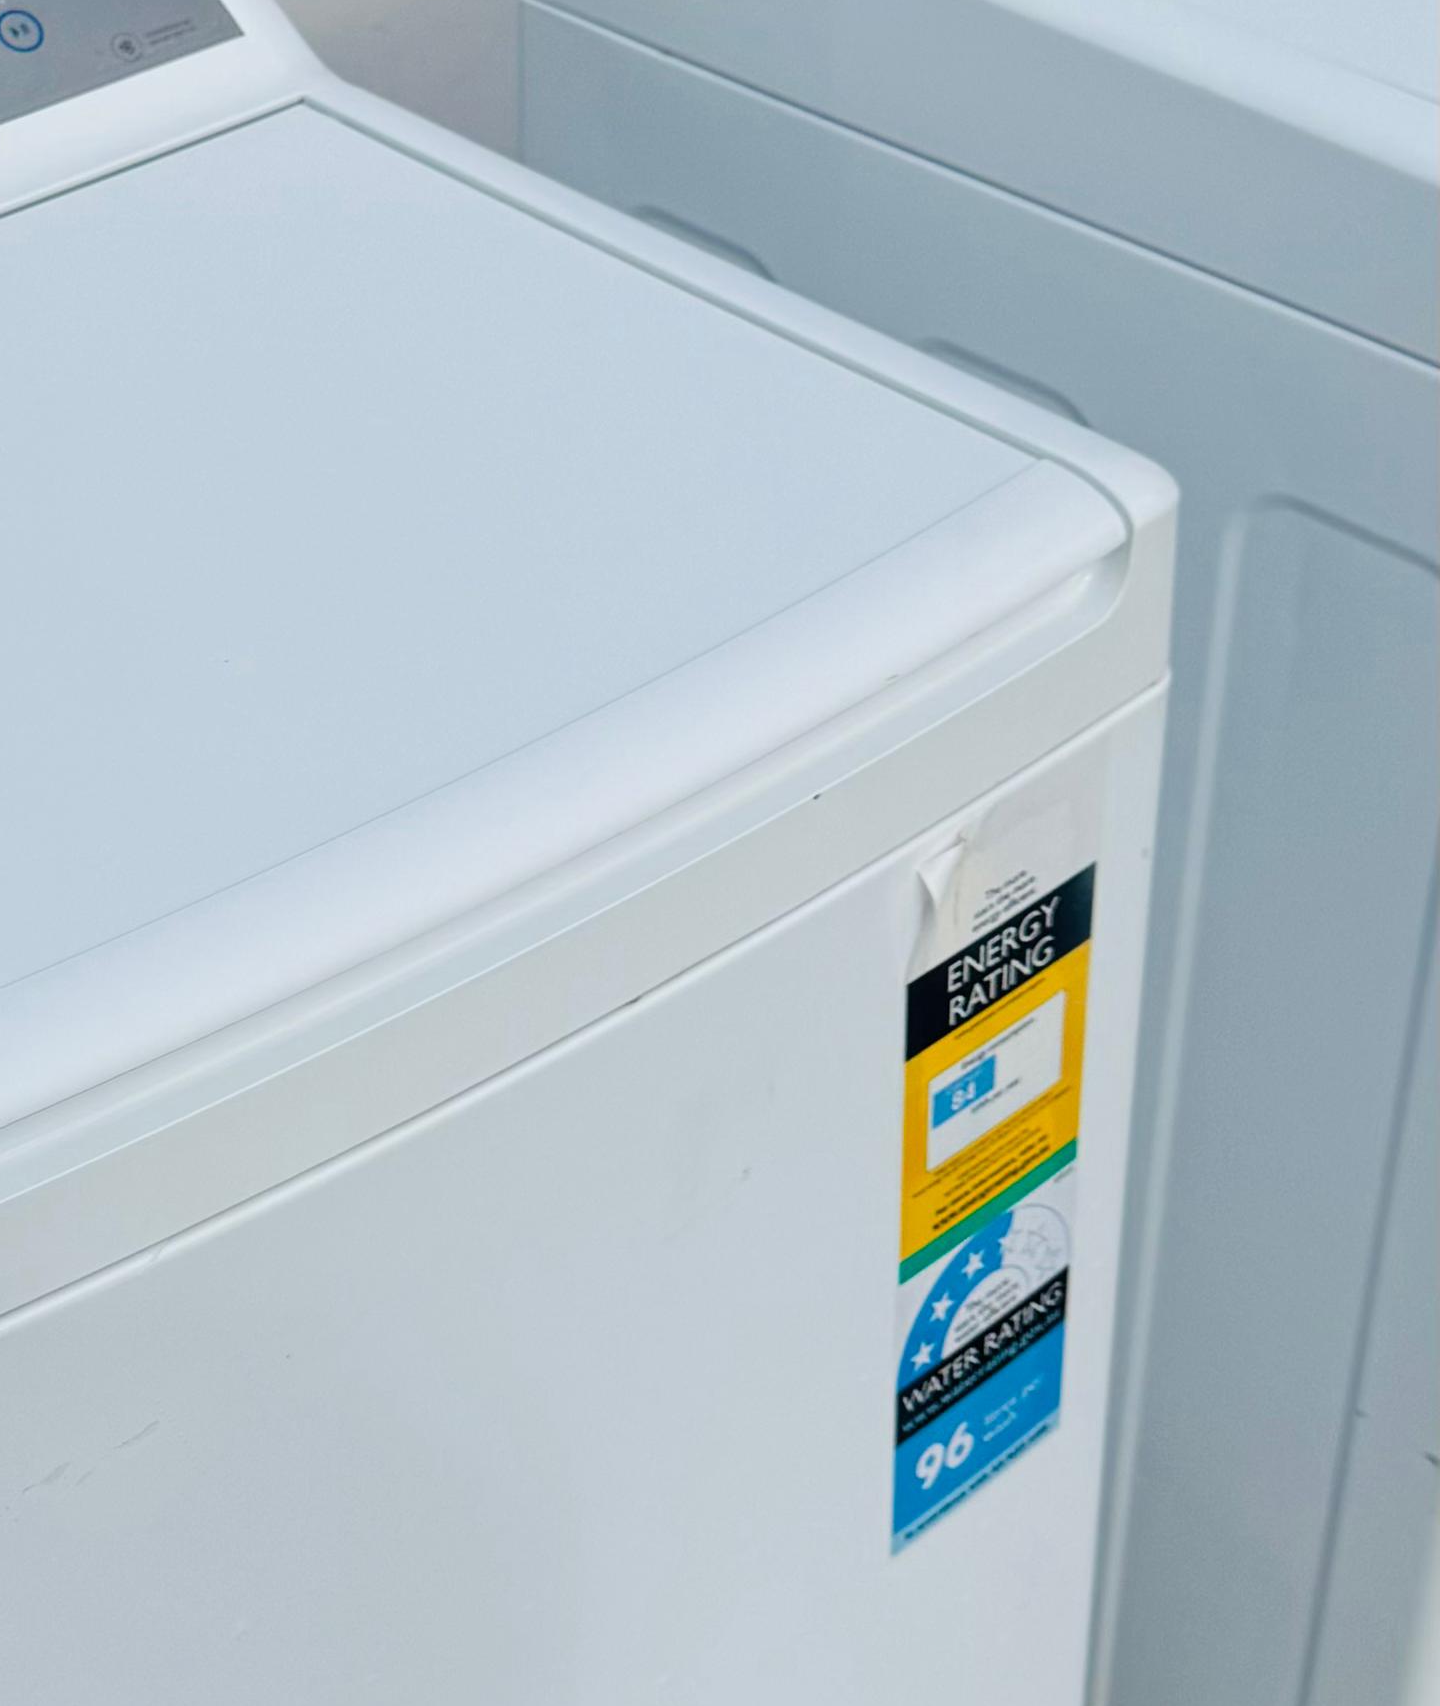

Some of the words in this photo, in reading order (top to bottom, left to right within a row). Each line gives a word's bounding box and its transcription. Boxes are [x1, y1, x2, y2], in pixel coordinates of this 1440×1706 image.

[947, 895, 1061, 993] ENERGY
[948, 935, 1056, 1026] RATING
[901, 1346, 981, 1412] WATER
[983, 1280, 1063, 1356] RATING
[915, 1421, 975, 1490] 96
